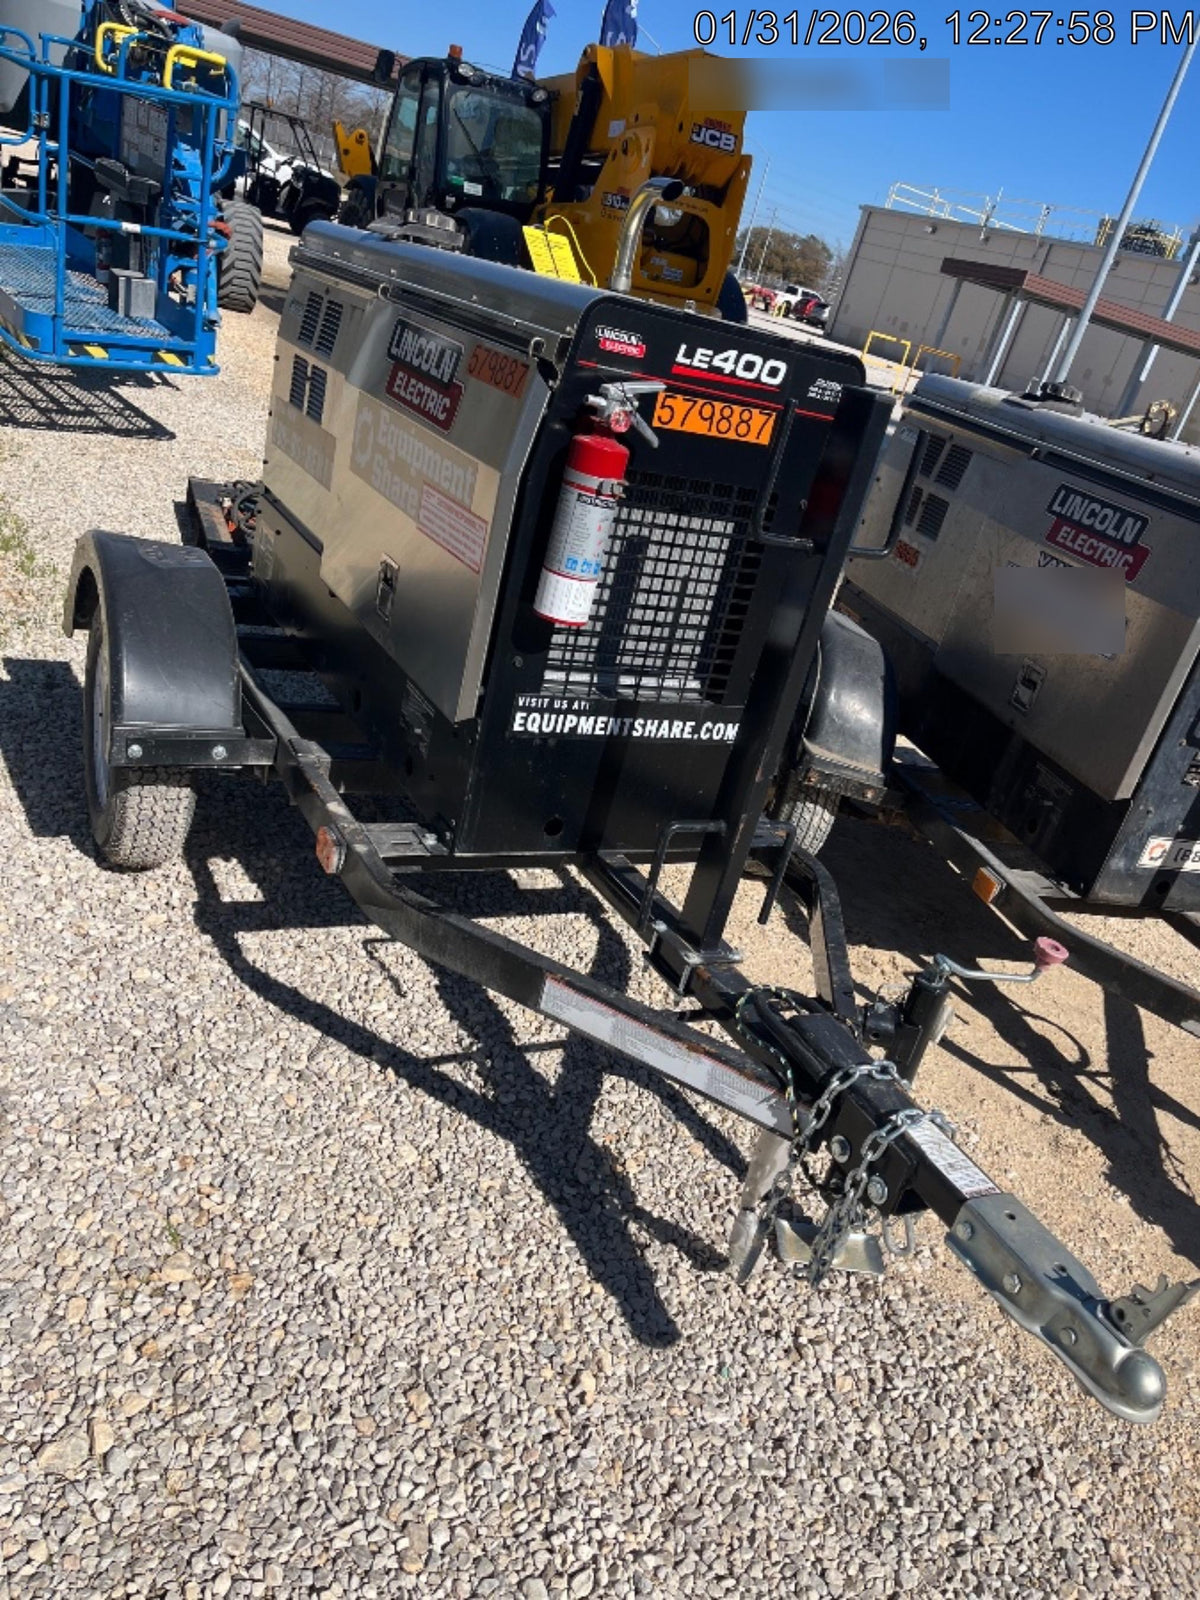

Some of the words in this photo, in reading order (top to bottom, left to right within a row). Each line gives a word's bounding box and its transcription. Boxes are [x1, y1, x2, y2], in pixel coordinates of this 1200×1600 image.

[691, 127, 735, 151] JCB
[391, 325, 457, 383] LINCOLN
[468, 343, 529, 394] 579887
[675, 344, 787, 385] LE400
[393, 371, 450, 420] ELECTRIC
[657, 395, 775, 440] 579887
[378, 408, 477, 507] Equipment
[371, 453, 420, 518] Share
[1051, 490, 1142, 545] LINCOLN
[1056, 525, 1134, 577] ELECTRIC
[512, 711, 739, 743] EQUIPMENTSHARE.COM
[517, 695, 549, 710] VISIT
[553, 699, 568, 711] US
